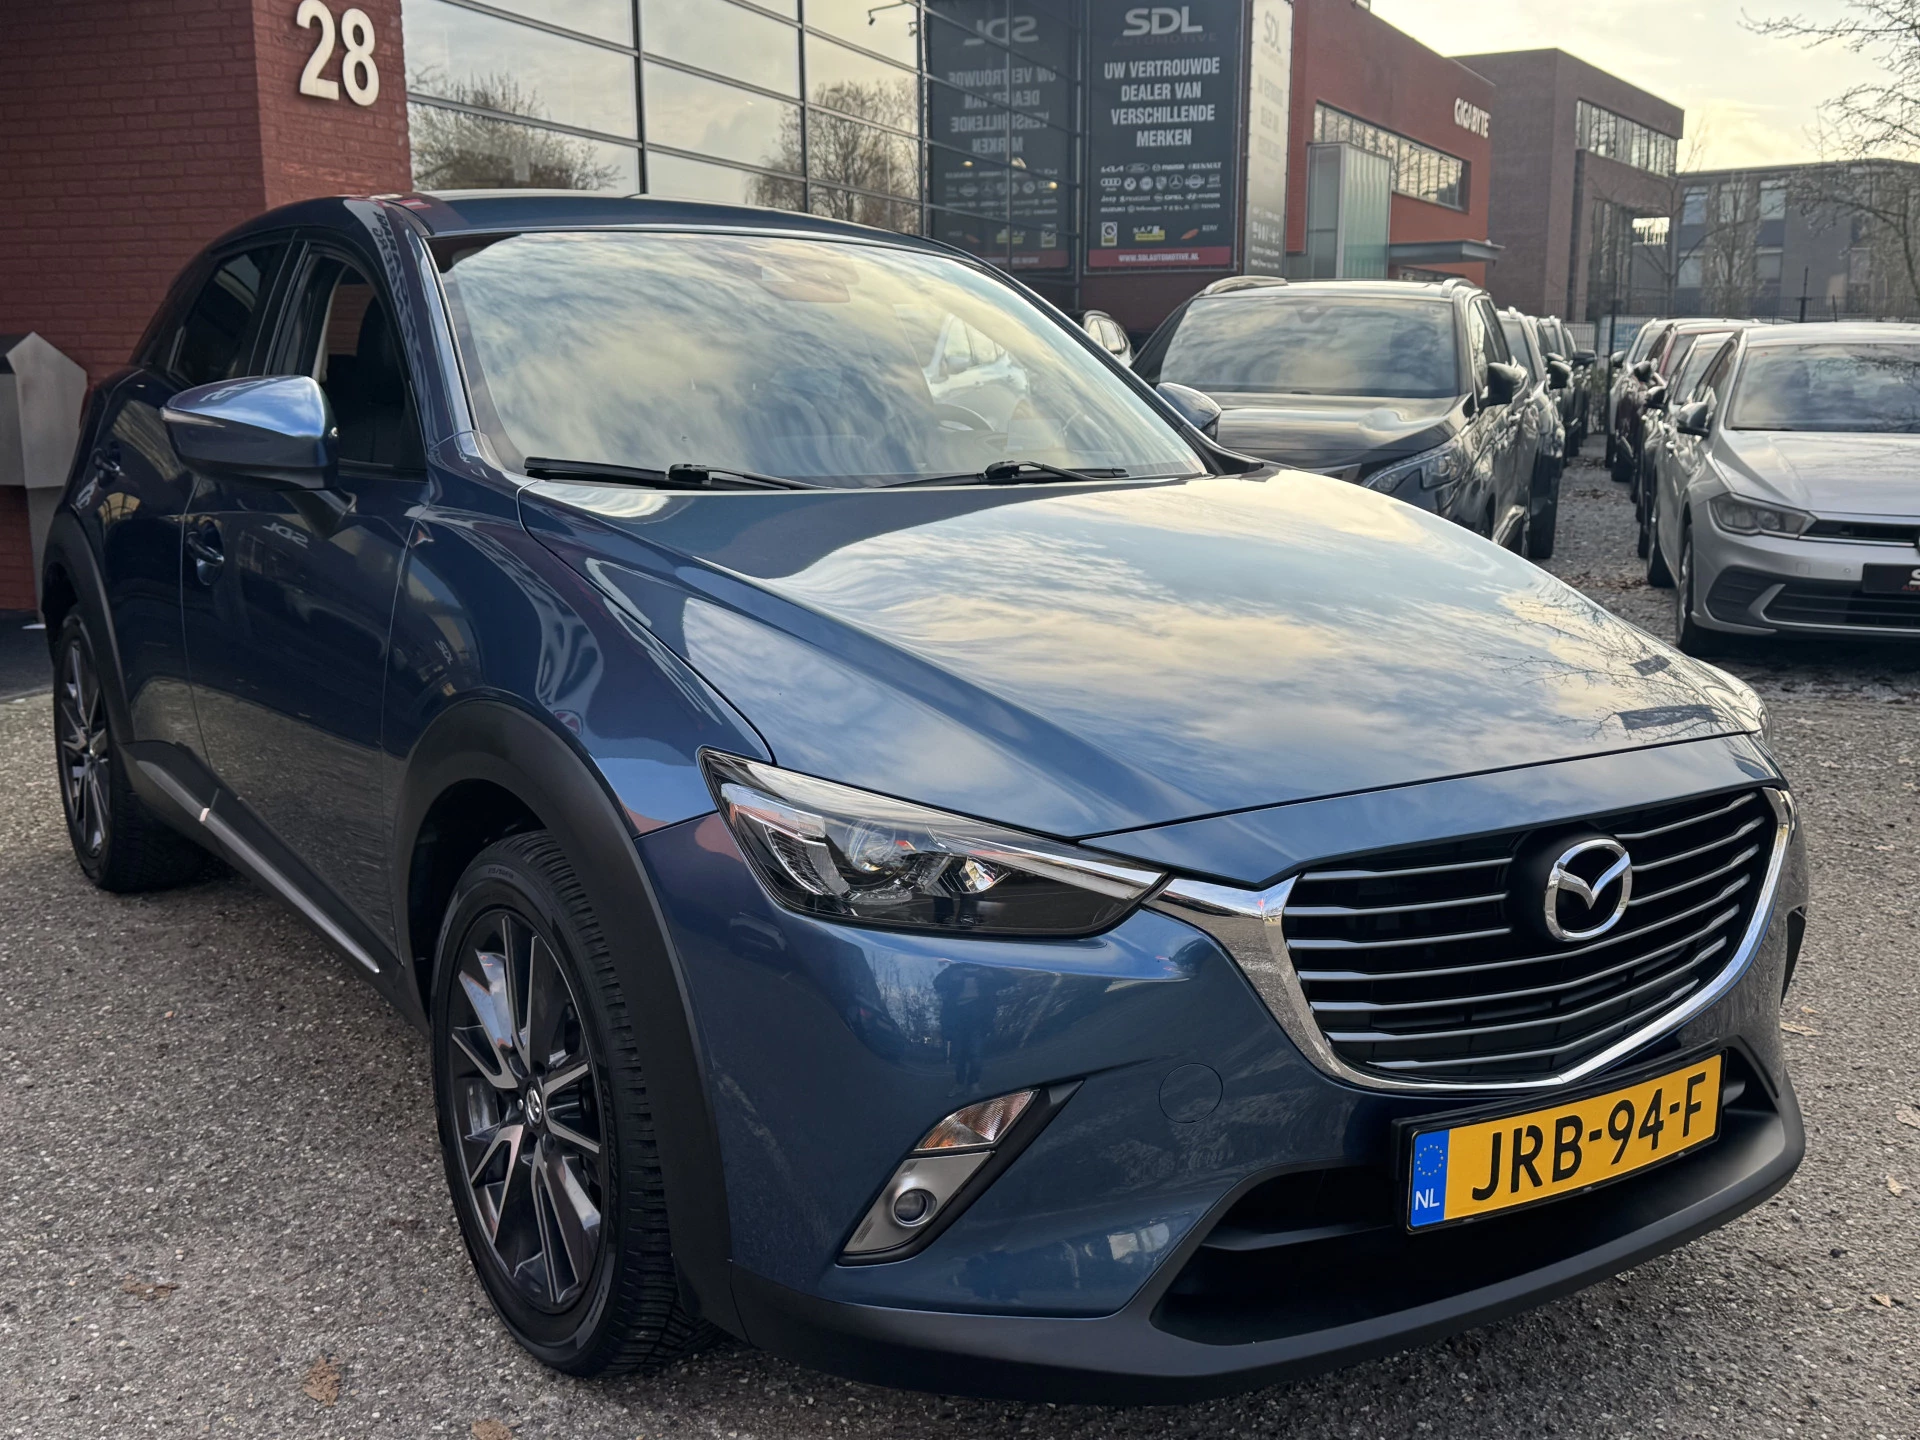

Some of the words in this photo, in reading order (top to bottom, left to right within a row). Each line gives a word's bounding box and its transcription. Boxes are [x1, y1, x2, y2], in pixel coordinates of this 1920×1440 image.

[1122, 6, 1203, 36] SDL
[296, 0, 379, 106] 28
[1104, 61, 1126, 79] UW
[1129, 57, 1220, 78] VERTROUWDE
[1121, 83, 1171, 102] DEALER
[1175, 81, 1202, 99] VAN
[1111, 104, 1215, 125] VERSCHILLENDE
[1136, 128, 1192, 147] MERKEN
[1472, 1072, 1706, 1201] JRB-94-F
[1415, 1188, 1440, 1211] NL
